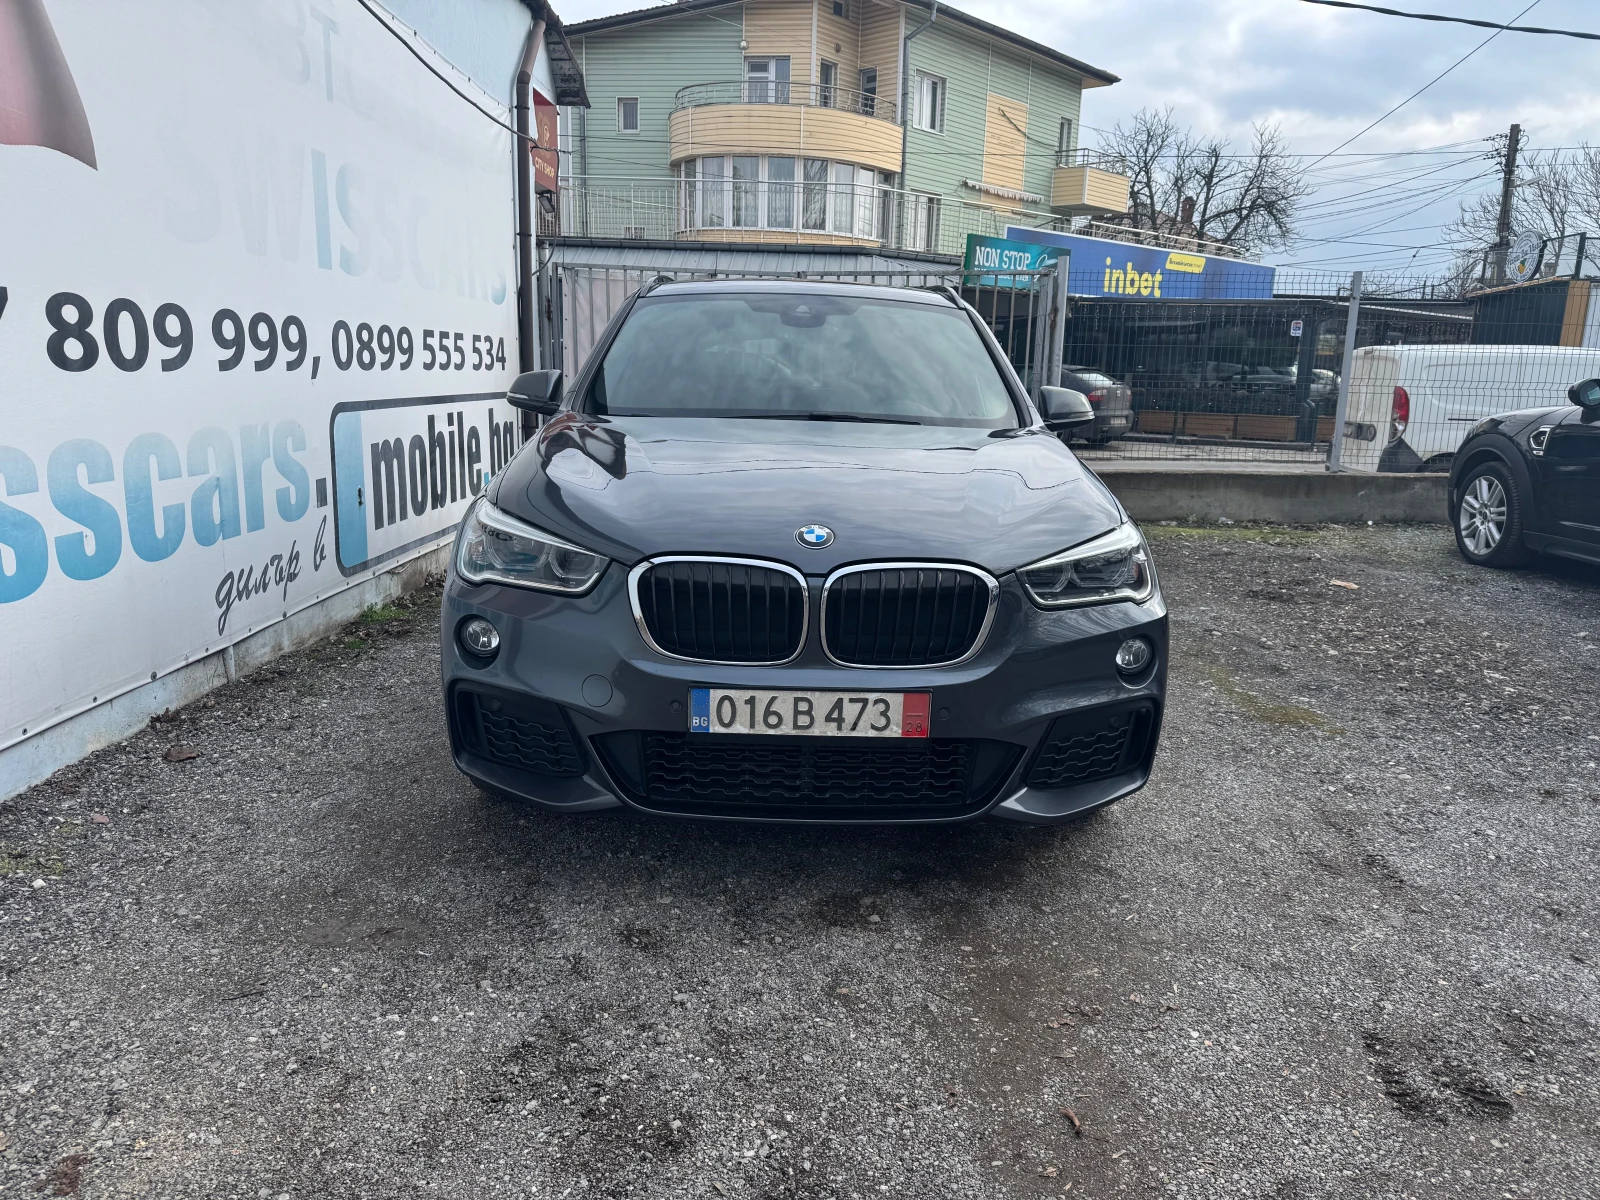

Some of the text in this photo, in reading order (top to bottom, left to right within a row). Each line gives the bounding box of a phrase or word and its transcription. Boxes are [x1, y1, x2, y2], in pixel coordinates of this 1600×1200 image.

[535, 157, 554, 178] CITY SHOP
[974, 245, 1000, 268] NON
[1002, 250, 1031, 270] STOP
[1103, 256, 1163, 298] inbet
[45, 292, 194, 373] 809
[211, 308, 321, 380] 999,
[331, 319, 414, 372] 0899
[422, 329, 465, 371] 555
[472, 335, 507, 371] 534
[692, 716, 709, 728] BG
[906, 721, 923, 733] 28
